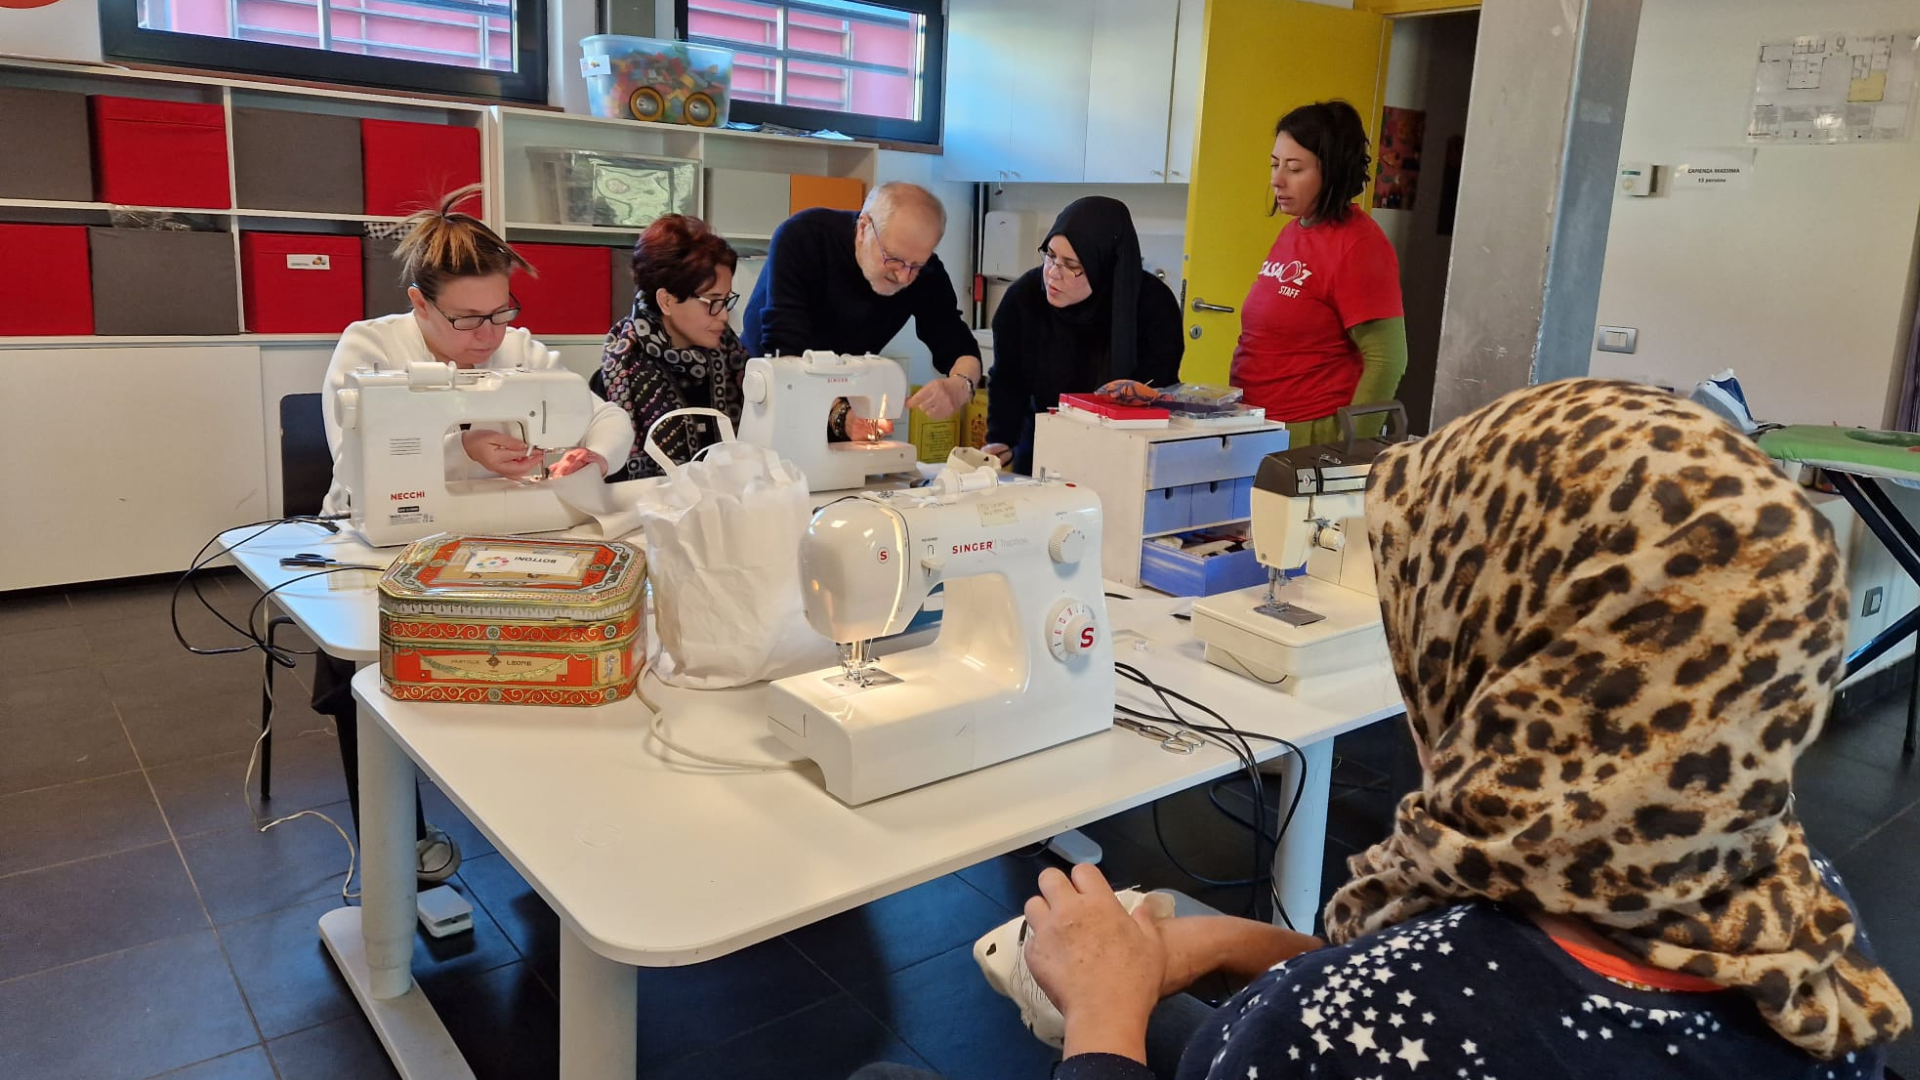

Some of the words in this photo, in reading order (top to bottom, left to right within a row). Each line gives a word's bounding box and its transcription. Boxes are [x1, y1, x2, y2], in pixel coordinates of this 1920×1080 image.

[1278, 286, 1300, 298] STAFF
[390, 490, 426, 501] NECCHI
[952, 541, 993, 555] SINGER
[514, 556, 557, 564] BOTTONI
[880, 550, 888, 561] S
[1080, 627, 1094, 648] S
